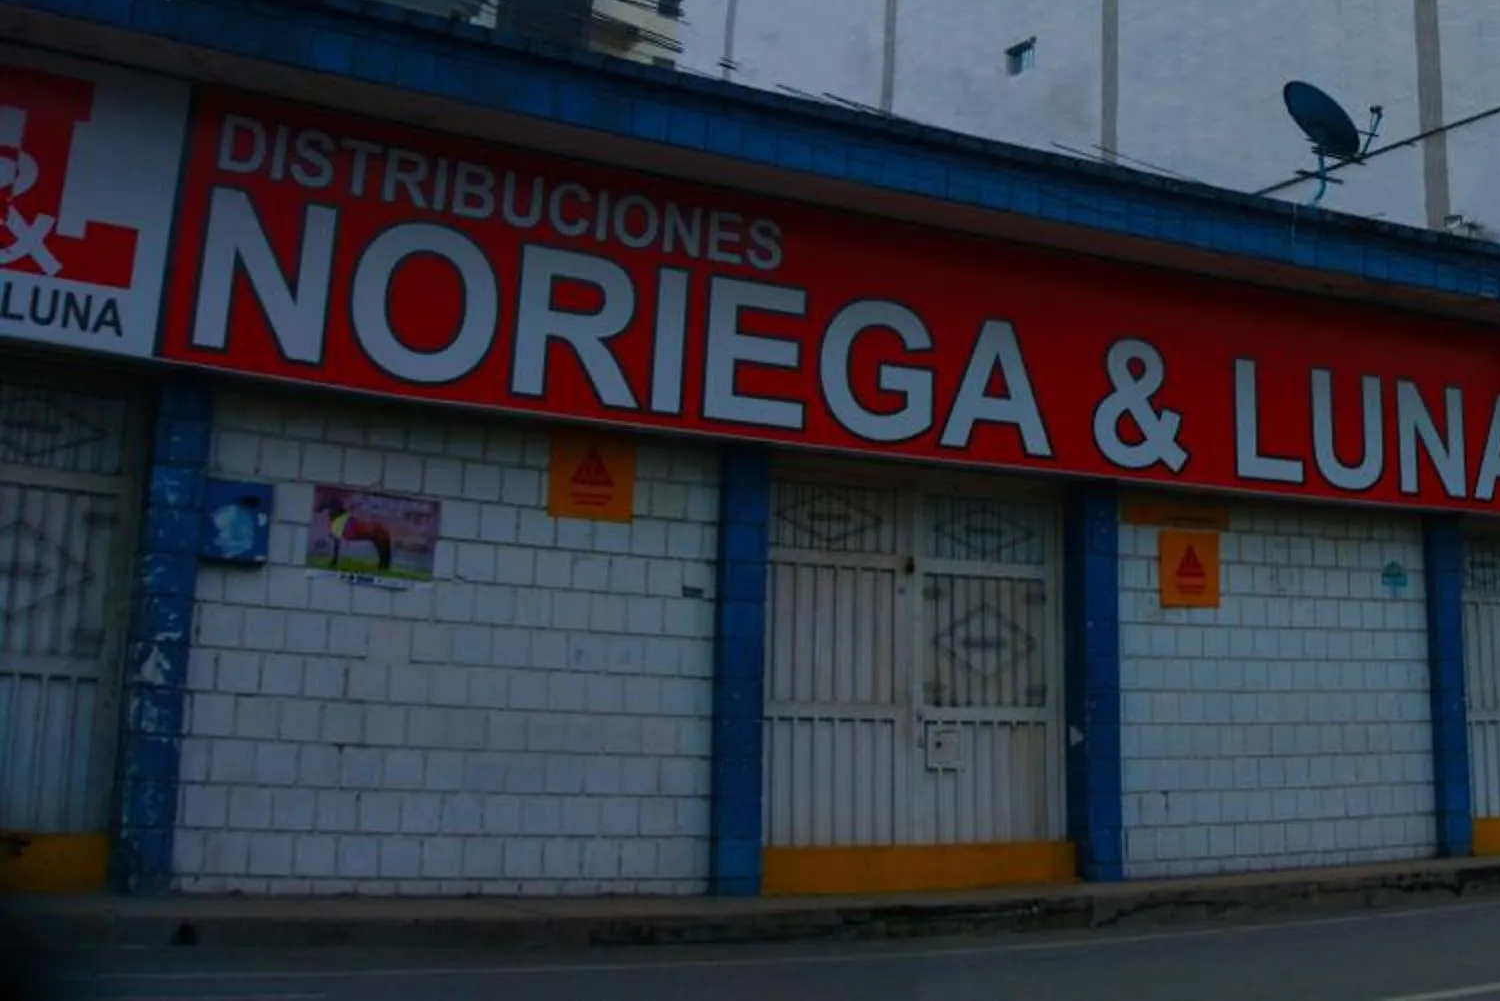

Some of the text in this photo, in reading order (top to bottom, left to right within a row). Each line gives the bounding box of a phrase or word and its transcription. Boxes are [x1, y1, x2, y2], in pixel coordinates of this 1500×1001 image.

[216, 114, 784, 271] DISTRIBUCIONES
[0, 281, 123, 337] LUNA
[191, 185, 1054, 460] NORIEGA
[1093, 337, 1190, 474] &
